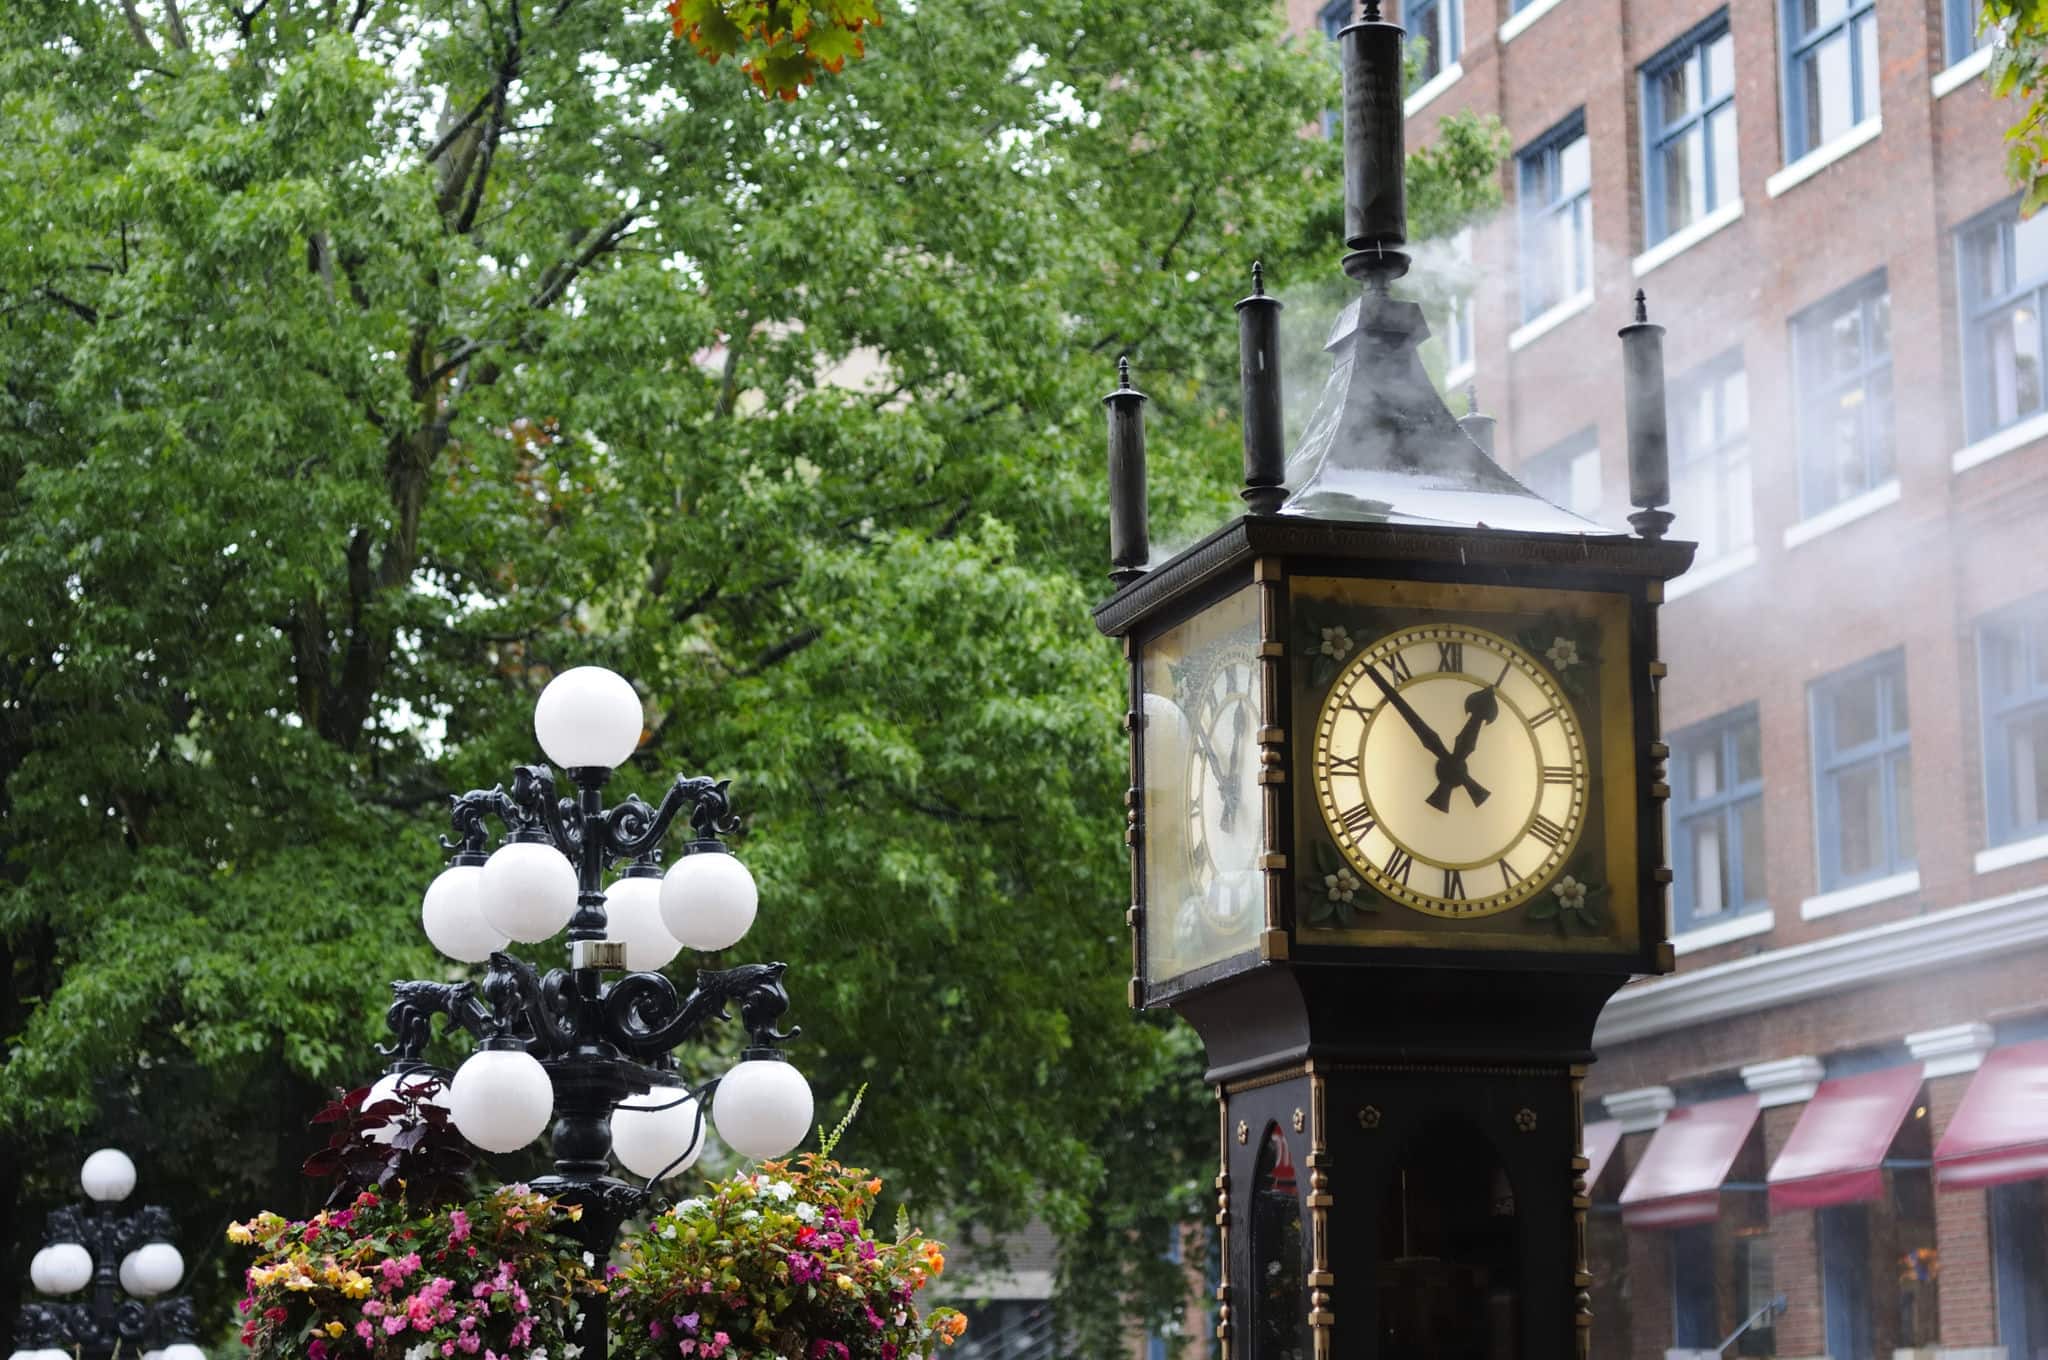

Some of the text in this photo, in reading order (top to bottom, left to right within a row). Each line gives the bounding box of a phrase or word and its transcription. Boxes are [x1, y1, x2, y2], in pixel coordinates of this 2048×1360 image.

[1382, 653, 1411, 685] XI
[1437, 641, 1463, 673] XII
[1343, 695, 1373, 723] X
[1529, 707, 1556, 728] II
[1330, 755, 1359, 777] IX
[1544, 766, 1573, 784] III
[1341, 803, 1376, 844] VIII
[1529, 815, 1561, 847] IIII
[1385, 847, 1412, 886] VII
[1499, 858, 1523, 889] V
[1444, 869, 1465, 900] VI
